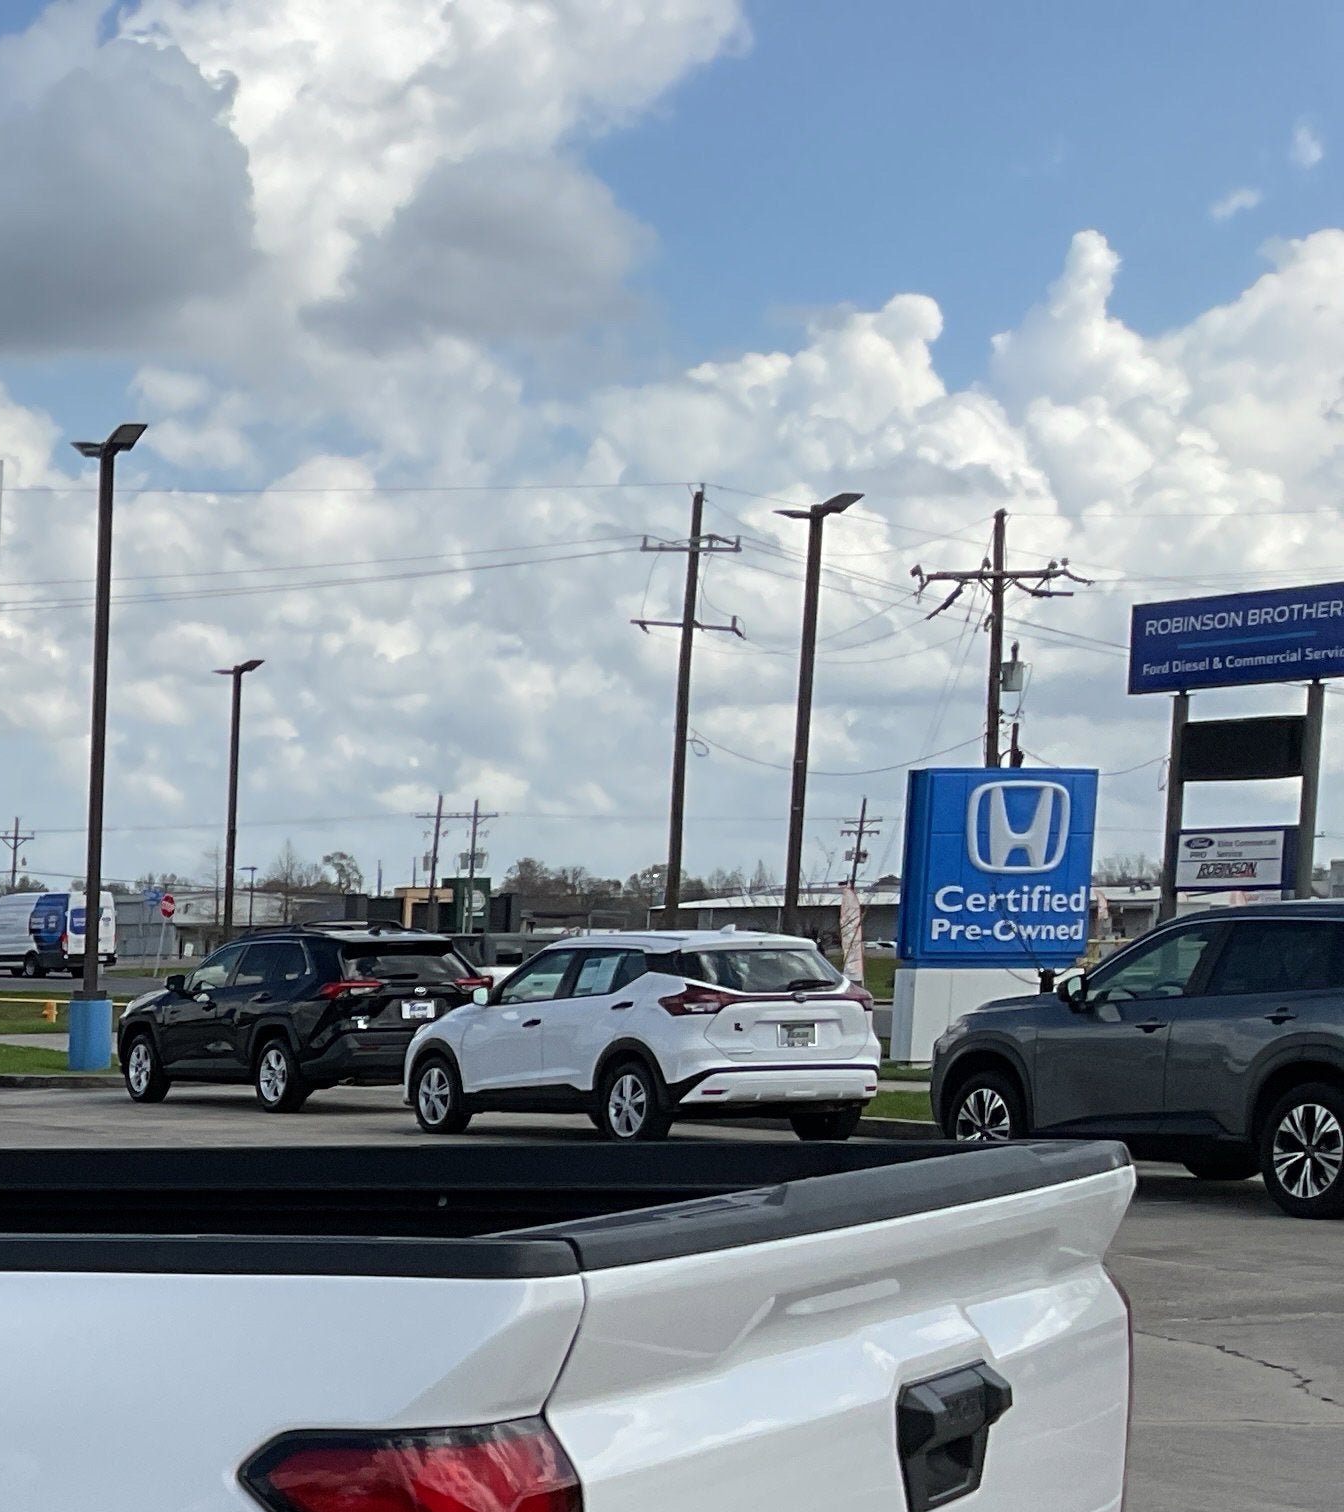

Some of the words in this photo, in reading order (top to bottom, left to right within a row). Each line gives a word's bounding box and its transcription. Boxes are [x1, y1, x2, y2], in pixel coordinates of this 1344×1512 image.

[1145, 611, 1243, 636] ROBINSON
[1247, 600, 1344, 626] BROTHER
[1142, 661, 1169, 676] Ford
[1172, 657, 1210, 673] Diesel
[1212, 656, 1223, 669] &
[1225, 650, 1301, 668] Commercial
[1197, 862, 1258, 879] ROBINSON
[935, 885, 1086, 913] Certified
[931, 918, 1084, 942] Pre-Owned
